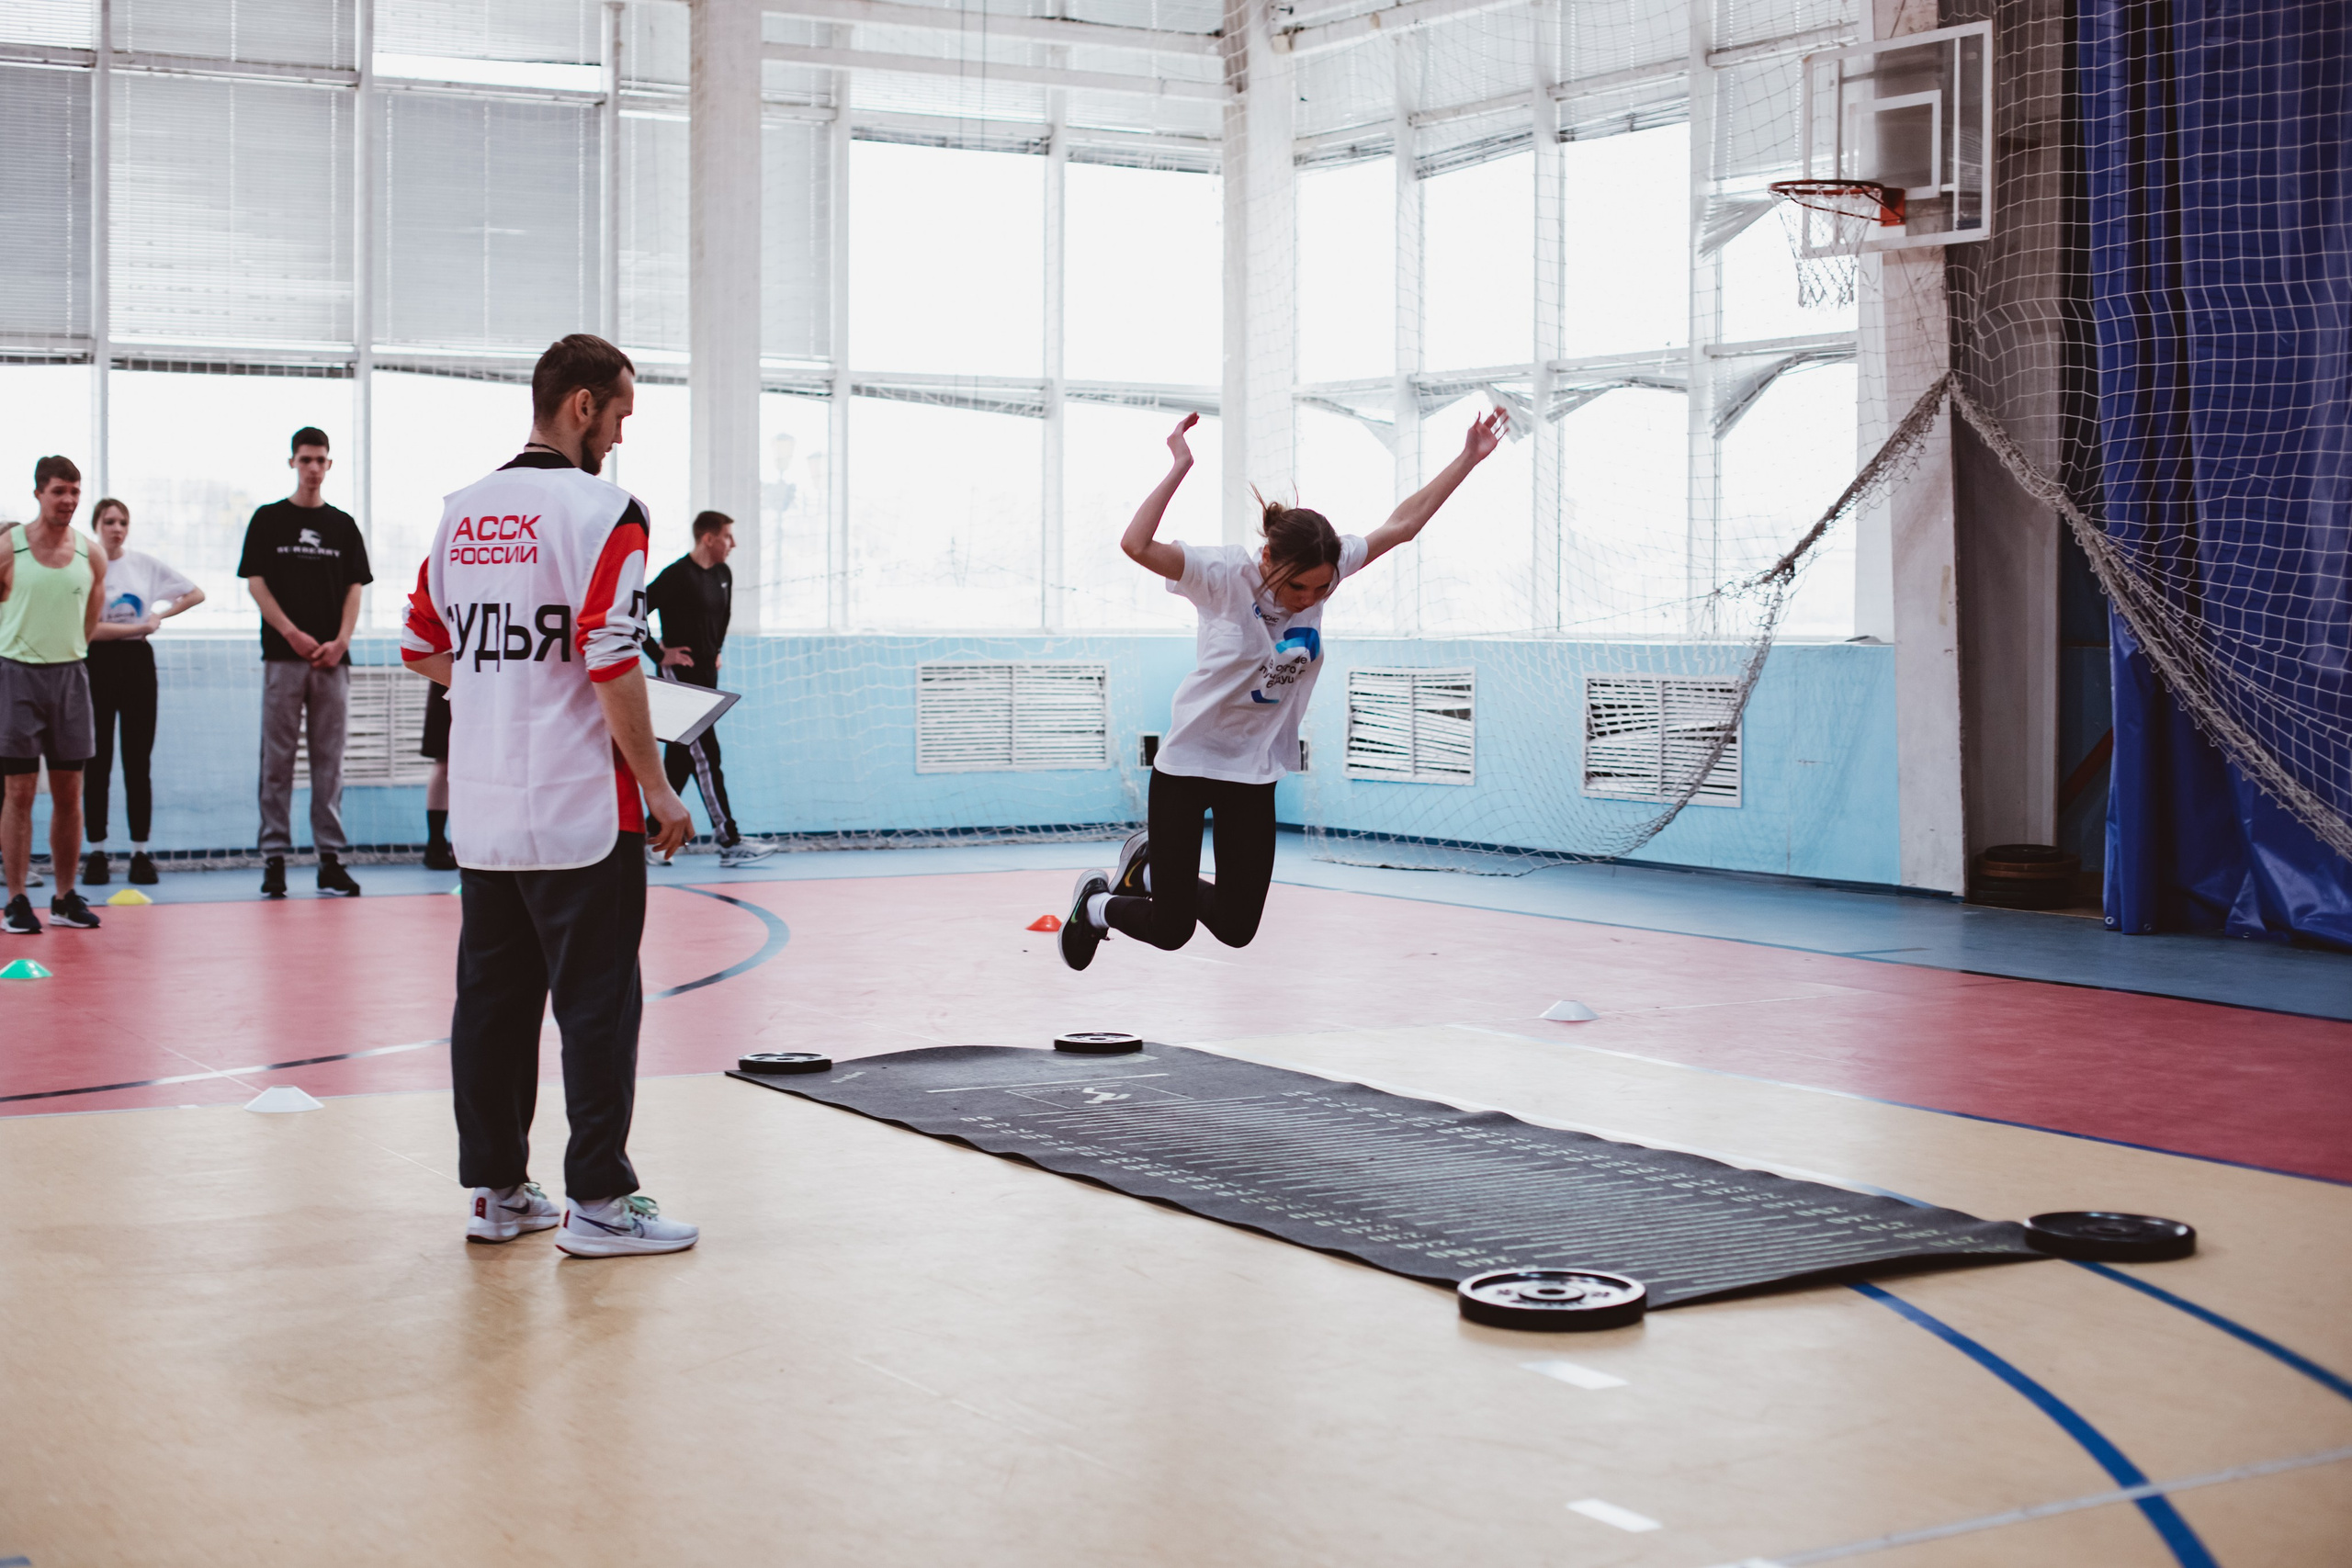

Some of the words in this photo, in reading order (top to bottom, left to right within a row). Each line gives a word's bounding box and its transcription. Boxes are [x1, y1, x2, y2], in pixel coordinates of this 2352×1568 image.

[453, 514, 542, 541] АССК
[450, 546, 537, 566] РОССИИ
[447, 603, 571, 672] УДЬЯ
